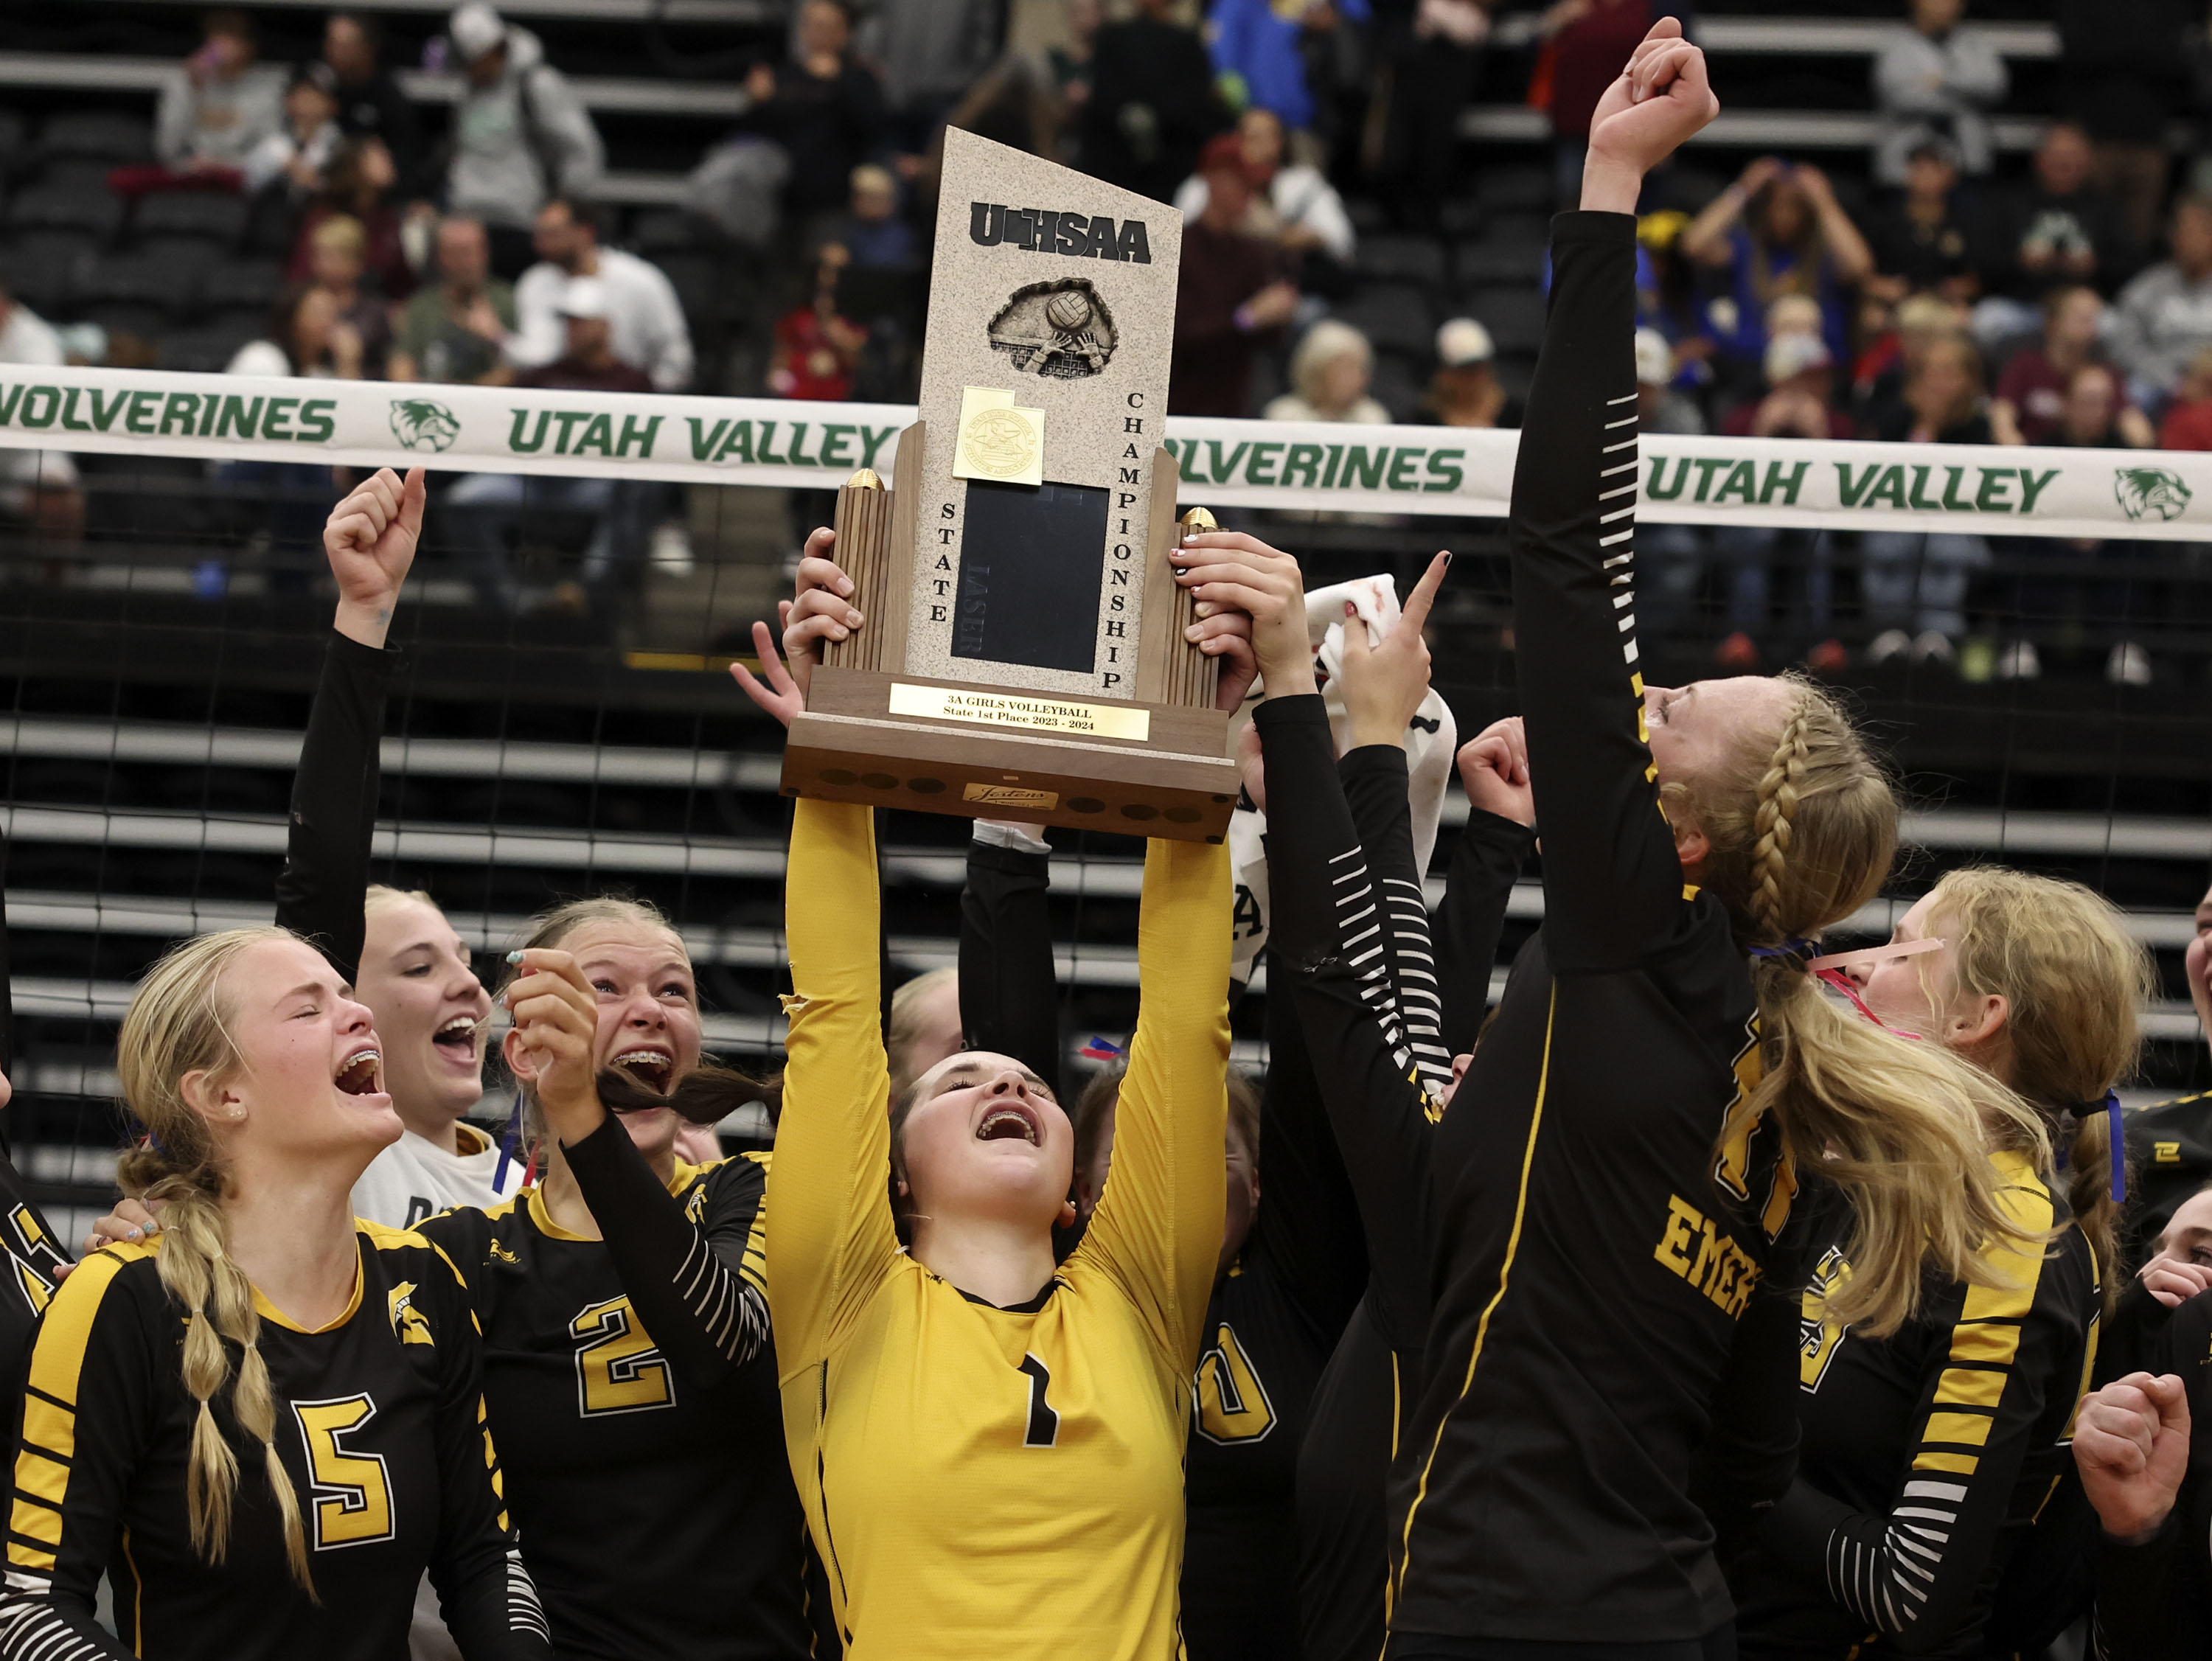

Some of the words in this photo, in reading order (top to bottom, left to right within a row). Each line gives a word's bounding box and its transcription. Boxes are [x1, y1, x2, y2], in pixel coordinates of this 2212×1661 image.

[970, 201, 1152, 265] UHSAA
[507, 408, 667, 459] UTAH
[684, 417, 901, 468] VALLEY
[1645, 456, 1813, 506] UTAH
[1833, 461, 2062, 514] VALLEY
[930, 503, 956, 622] STATE
[1102, 392, 1144, 689] CHAMPIONSHIP
[944, 706, 973, 717] State
[978, 710, 993, 719] 1st
[998, 711, 1029, 722] Place
[1032, 715, 1058, 726] 2023
[1068, 720, 1094, 731] 2024
[947, 695, 962, 705] 3A
[967, 697, 1005, 708] GIRLS
[1009, 701, 1092, 719] VOLLEYBALL
[1654, 1193, 1762, 1321] EMER
[568, 1293, 677, 1418] 2
[1022, 1350, 1062, 1449] 1
[290, 1391, 396, 1552] 5
